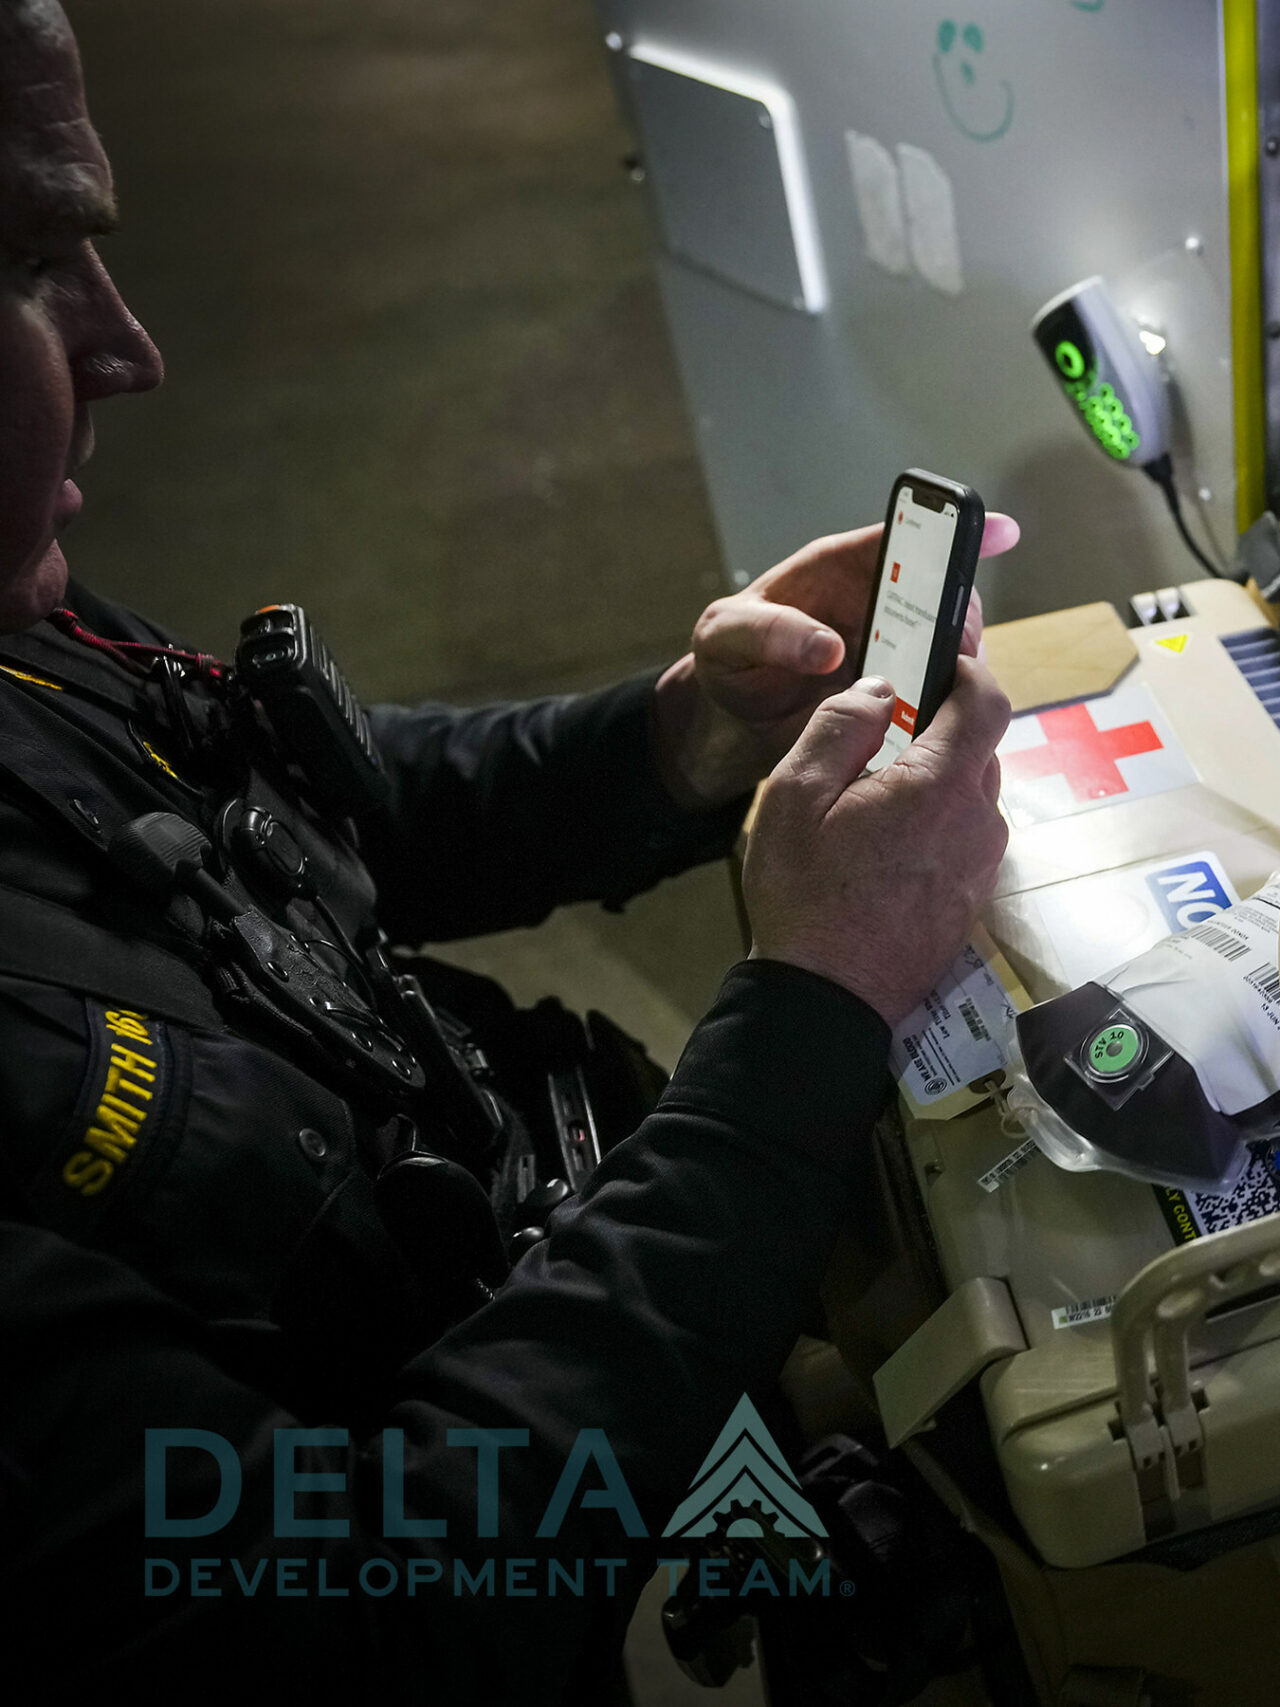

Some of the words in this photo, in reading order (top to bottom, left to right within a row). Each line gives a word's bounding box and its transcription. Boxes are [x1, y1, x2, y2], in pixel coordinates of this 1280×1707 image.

[1266, 1011, 1279, 1025] JUN
[938, 1024, 950, 1039] Low
[1109, 1030, 1125, 1040] 10
[901, 1036, 919, 1059] BLOOD
[912, 1056, 927, 1072] ARE
[920, 1069, 931, 1081] WE
[62, 1043, 158, 1197] SMITH
